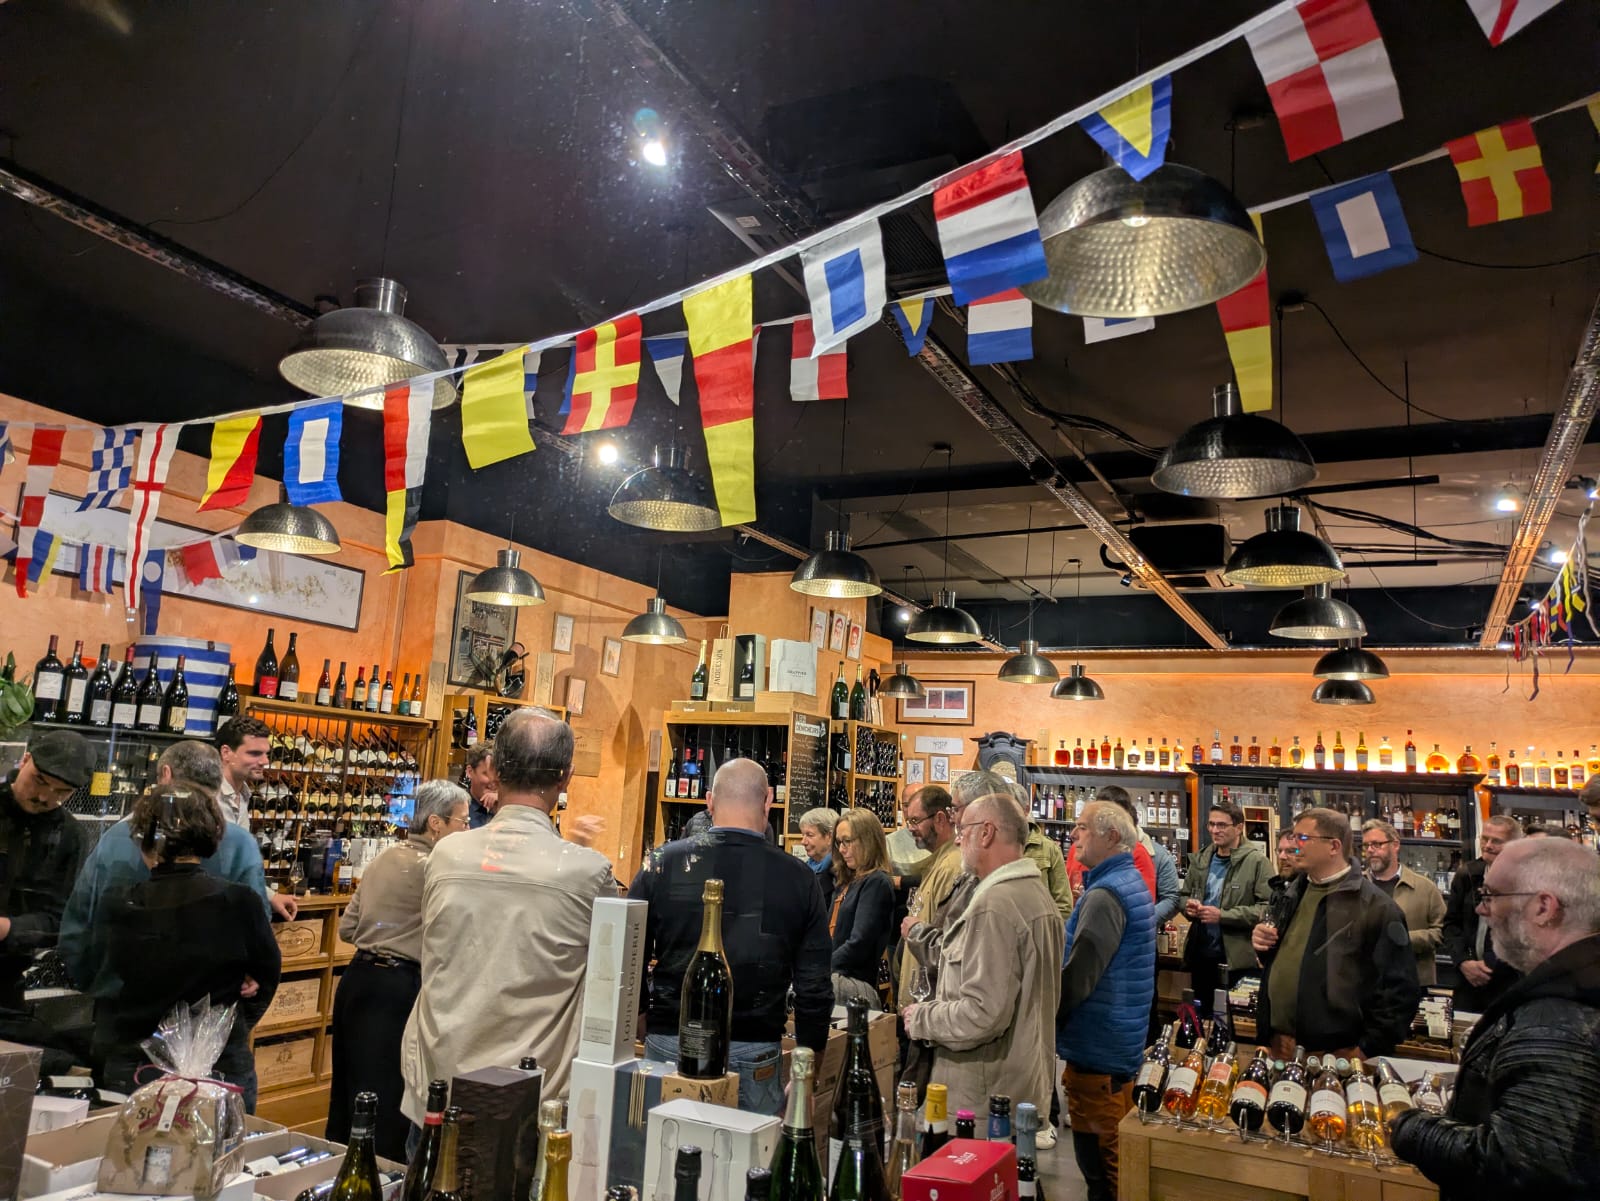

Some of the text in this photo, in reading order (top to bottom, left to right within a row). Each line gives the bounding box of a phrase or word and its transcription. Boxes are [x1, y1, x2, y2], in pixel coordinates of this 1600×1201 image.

[714, 649, 723, 686] JACQUESSON
[622, 922, 640, 1043] LOUIS ROEDERER
